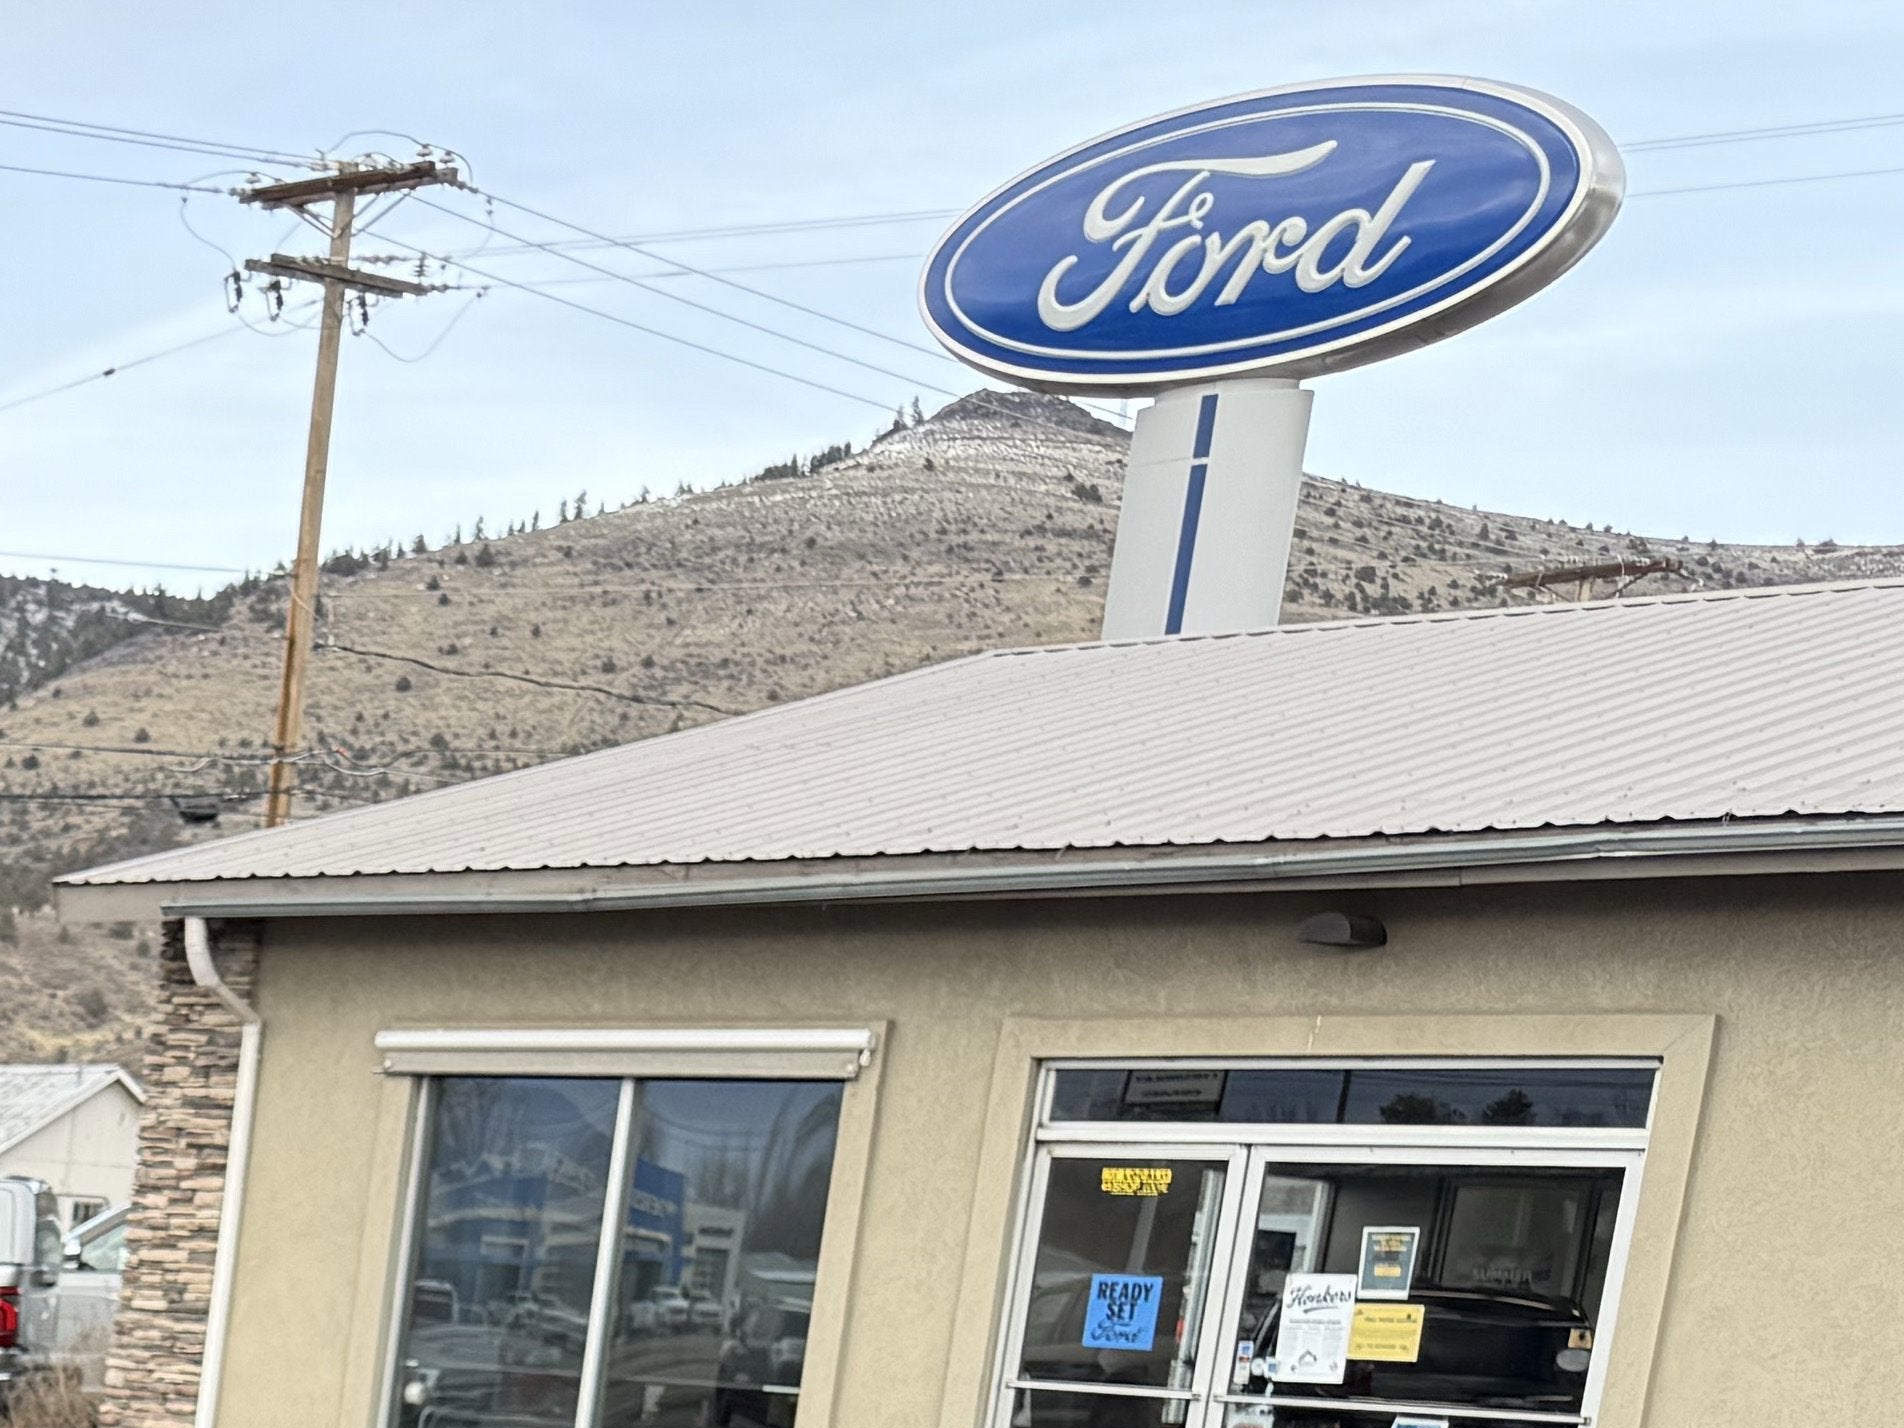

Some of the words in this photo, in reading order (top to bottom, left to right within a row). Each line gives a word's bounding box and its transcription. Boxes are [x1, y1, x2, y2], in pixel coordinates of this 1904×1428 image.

[1037, 139, 1436, 332] Ford
[1097, 1281, 1154, 1303] READY
[1106, 1302, 1137, 1321] SET
